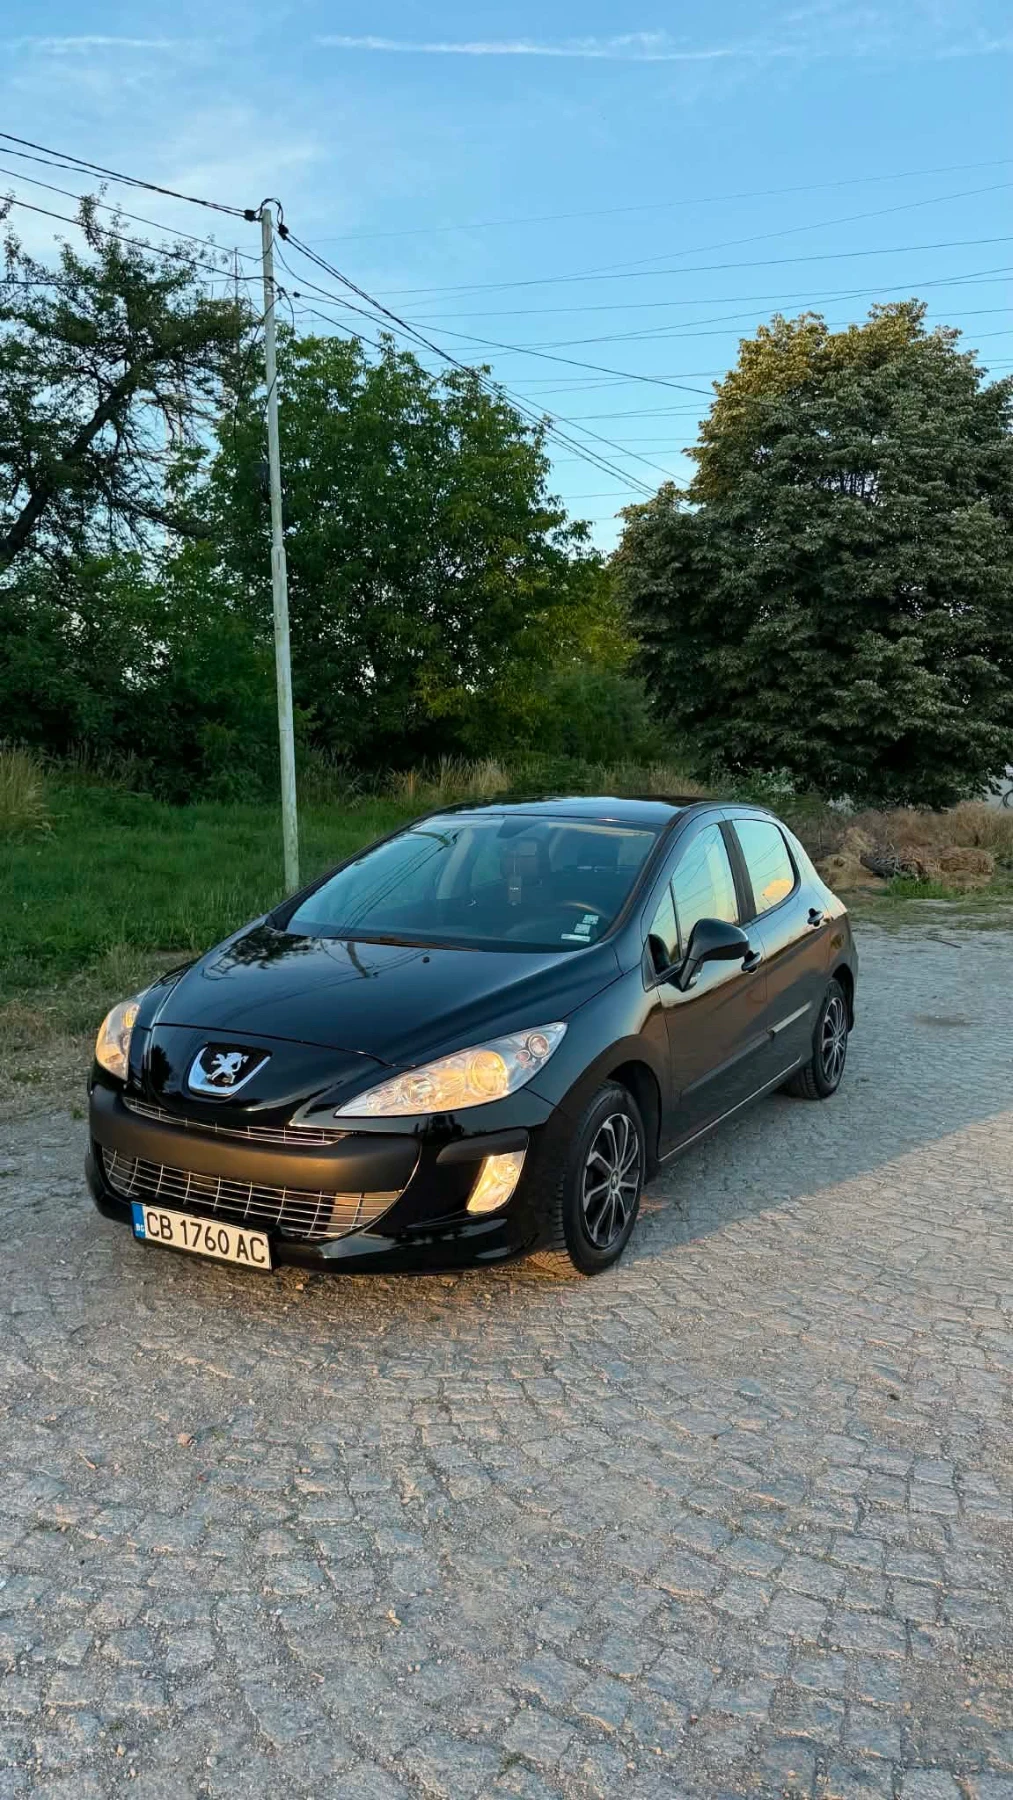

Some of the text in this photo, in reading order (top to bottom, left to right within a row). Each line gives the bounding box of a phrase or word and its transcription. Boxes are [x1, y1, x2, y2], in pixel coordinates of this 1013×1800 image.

[146, 1211, 266, 1264] CB 1760 AC
